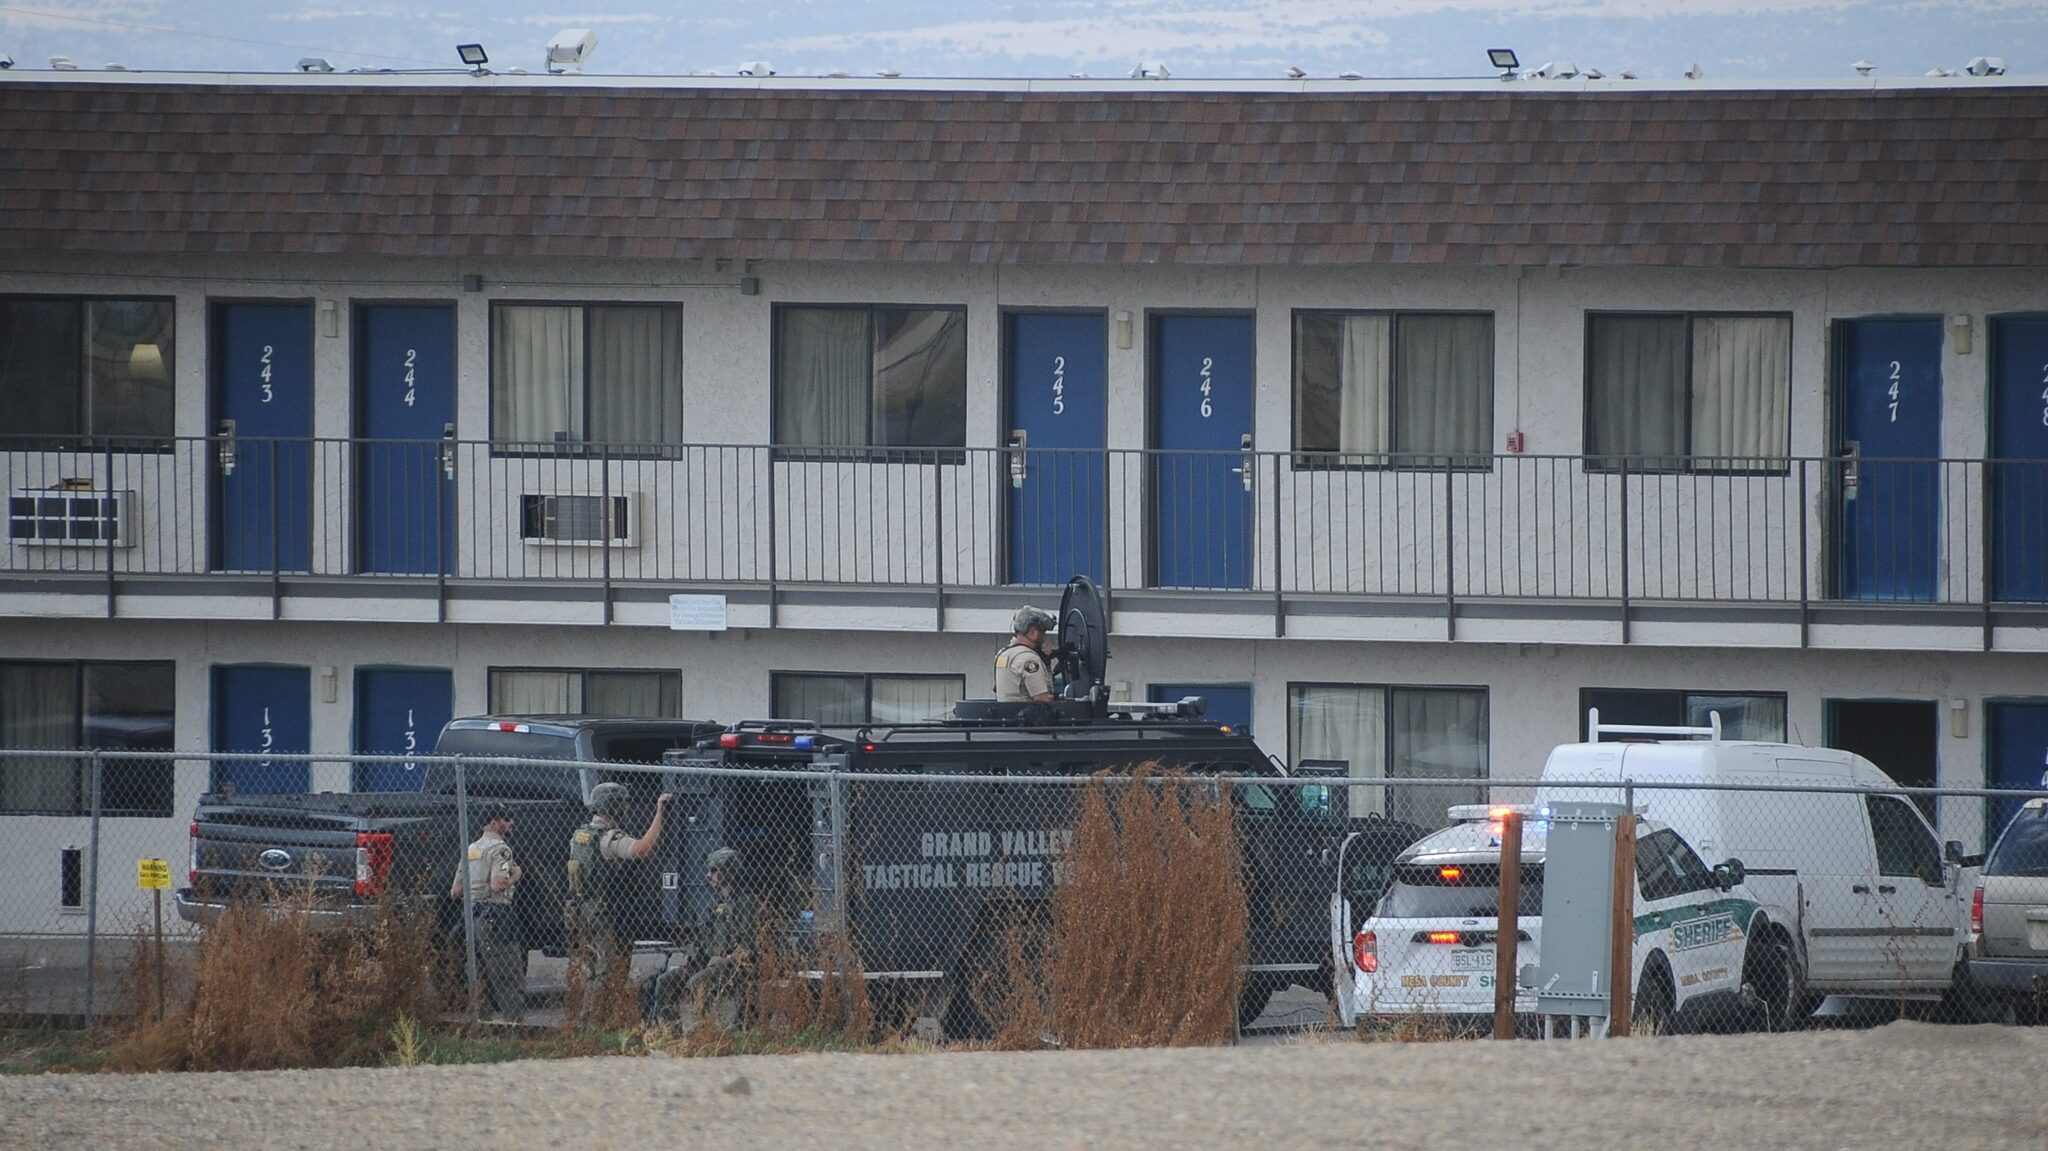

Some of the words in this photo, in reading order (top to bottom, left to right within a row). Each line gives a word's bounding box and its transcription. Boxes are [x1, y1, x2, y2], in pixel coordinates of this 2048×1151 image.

[261, 345, 273, 402] 243
[404, 349, 417, 407] 244
[1052, 356, 1065, 414] 245
[1200, 357, 1213, 418] 246
[1887, 360, 1901, 422] 247
[921, 831, 991, 857] GRAND
[1001, 830, 1074, 855] VALLEY
[862, 864, 958, 889] TACTICAL
[966, 862, 1043, 888] RESCUE
[1673, 918, 1732, 951] SHERIFF
[1401, 975, 1427, 987] MESA
[1430, 975, 1469, 987] COUNTY
